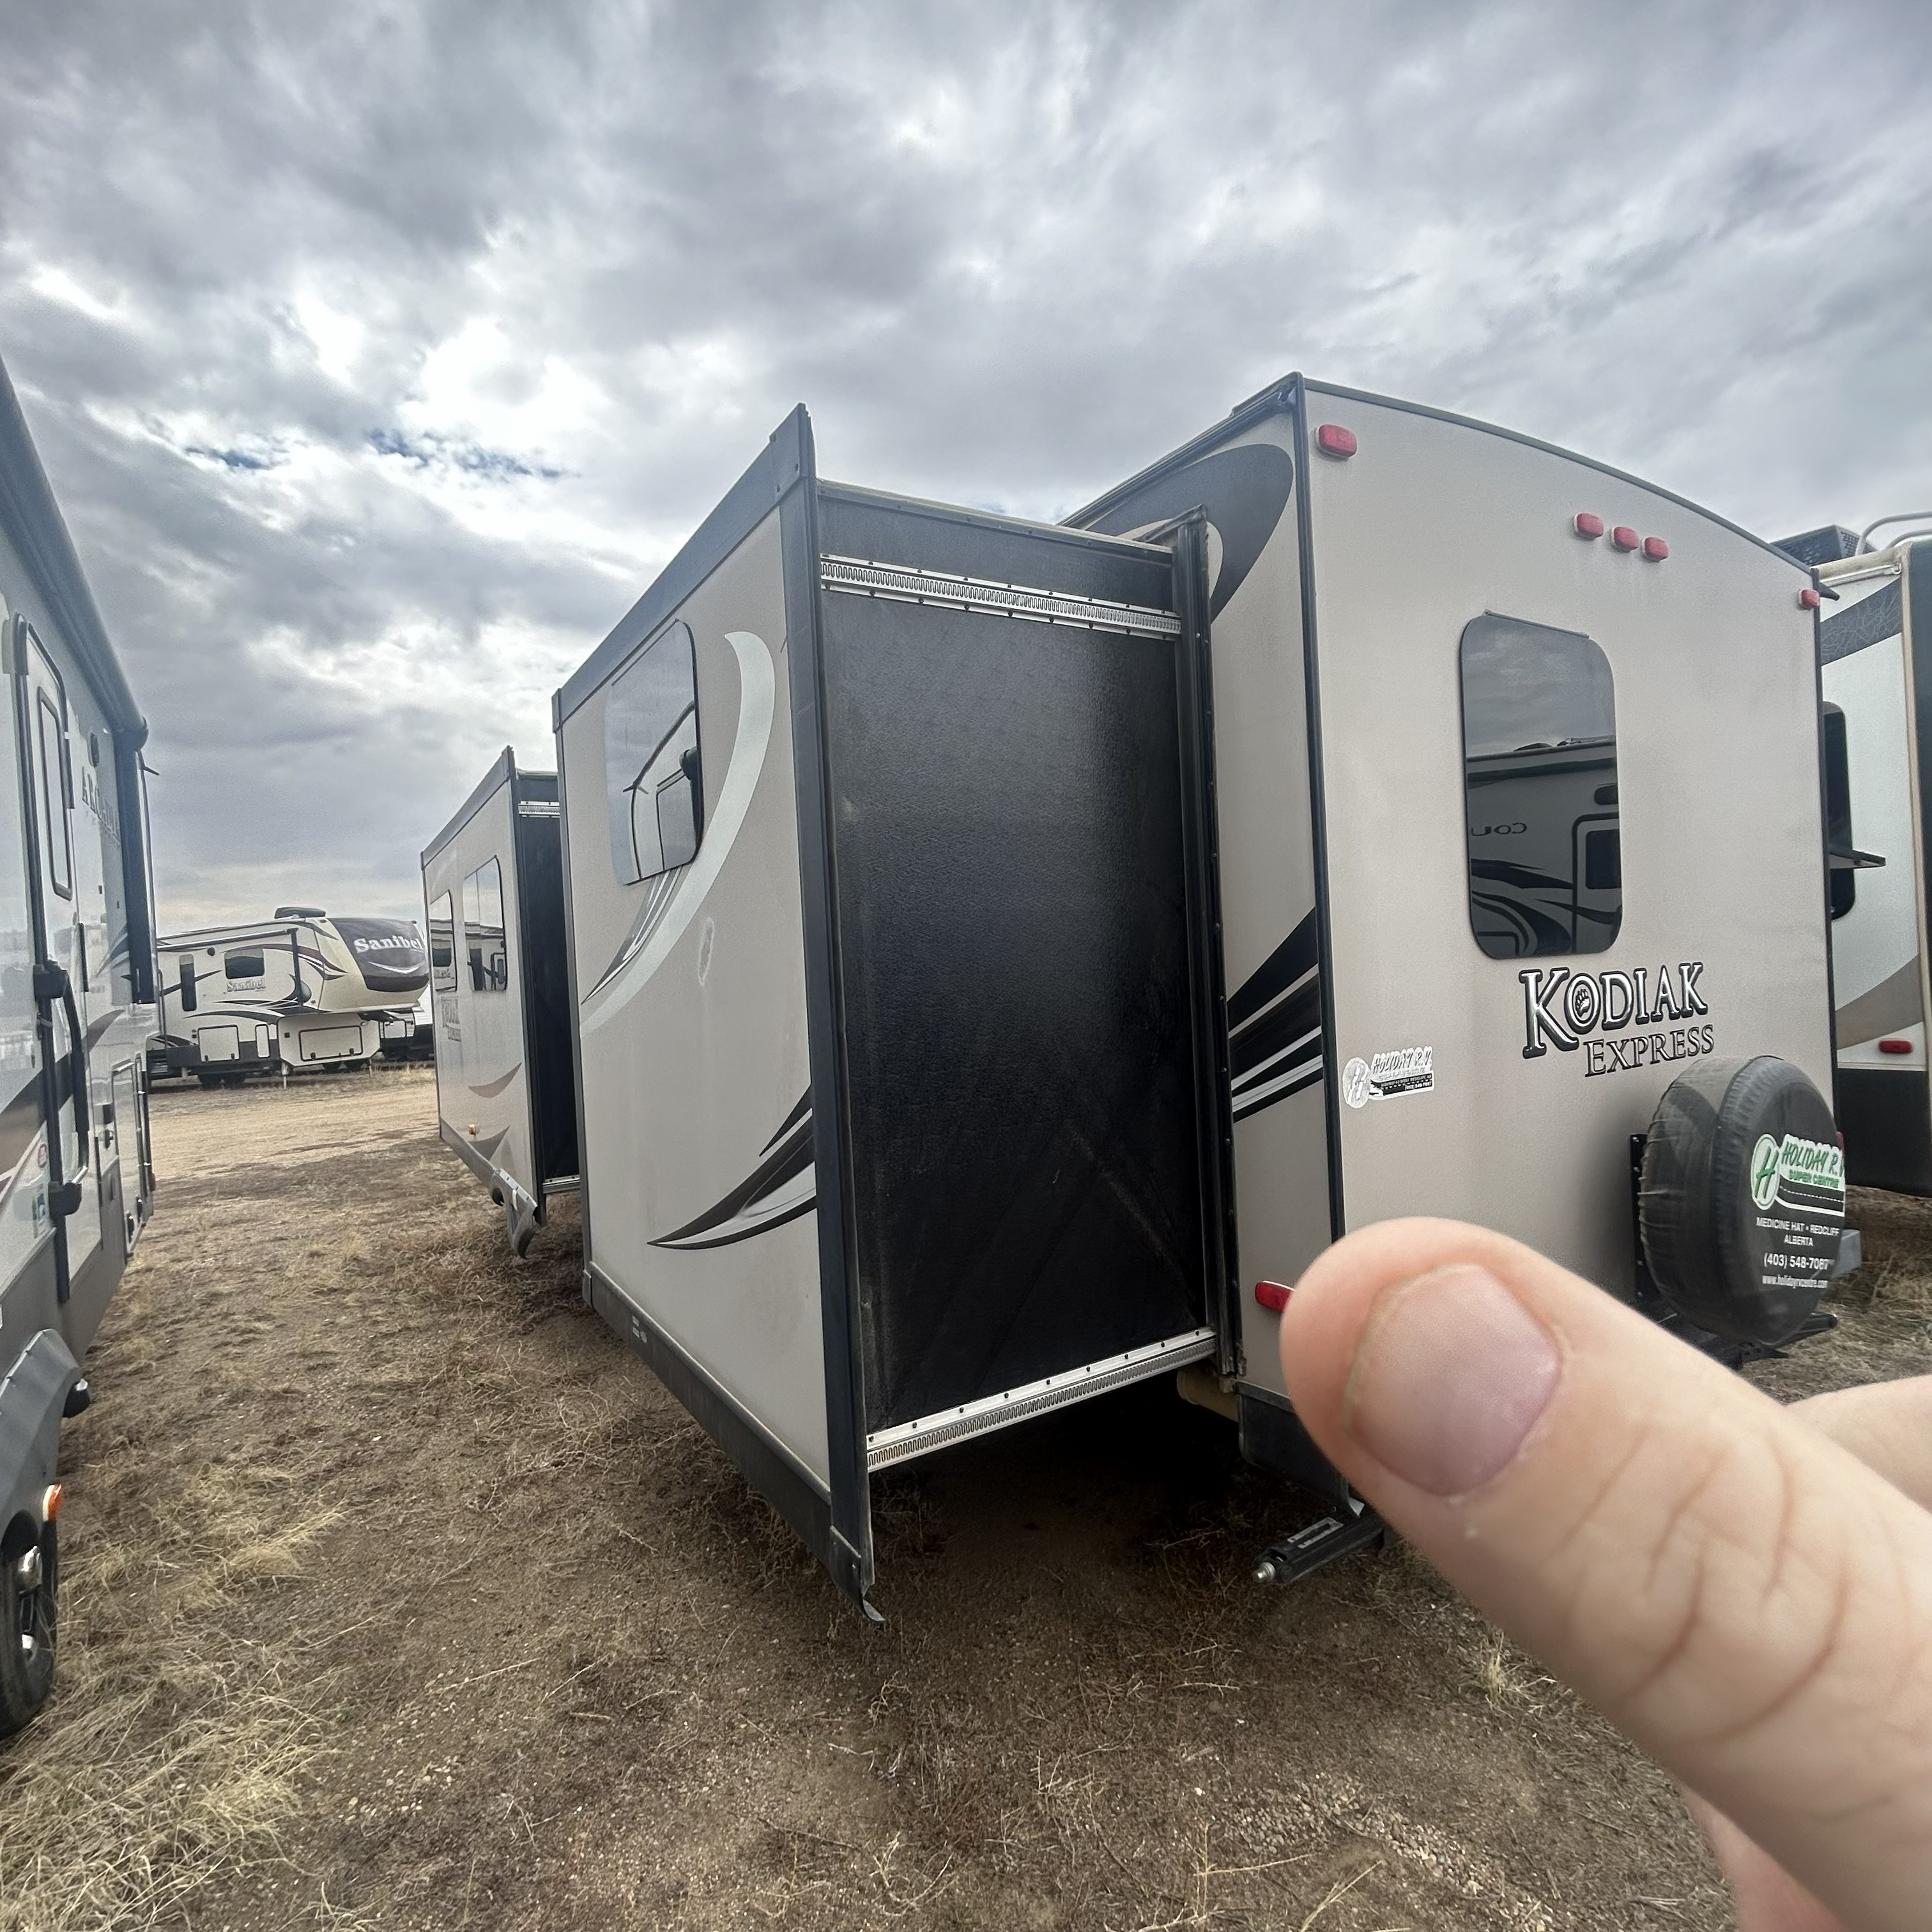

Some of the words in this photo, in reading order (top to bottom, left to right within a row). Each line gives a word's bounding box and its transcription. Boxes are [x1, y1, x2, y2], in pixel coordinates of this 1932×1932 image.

[1519, 962, 1708, 1059] KODIAK
[1583, 1023, 1715, 1078] EXPRESS
[1781, 1141, 1829, 1174] HOLIDAY
[1790, 1169, 1812, 1182] SUPER
[1813, 1174, 1839, 1189] CENTRE
[1756, 1216, 1790, 1230] MEDICINE
[1791, 1222, 1805, 1232] HAT
[1809, 1224, 1841, 1237] REDCLIFF
[1784, 1234, 1814, 1246] ALBERTA
[1764, 1252, 1788, 1269] (403)
